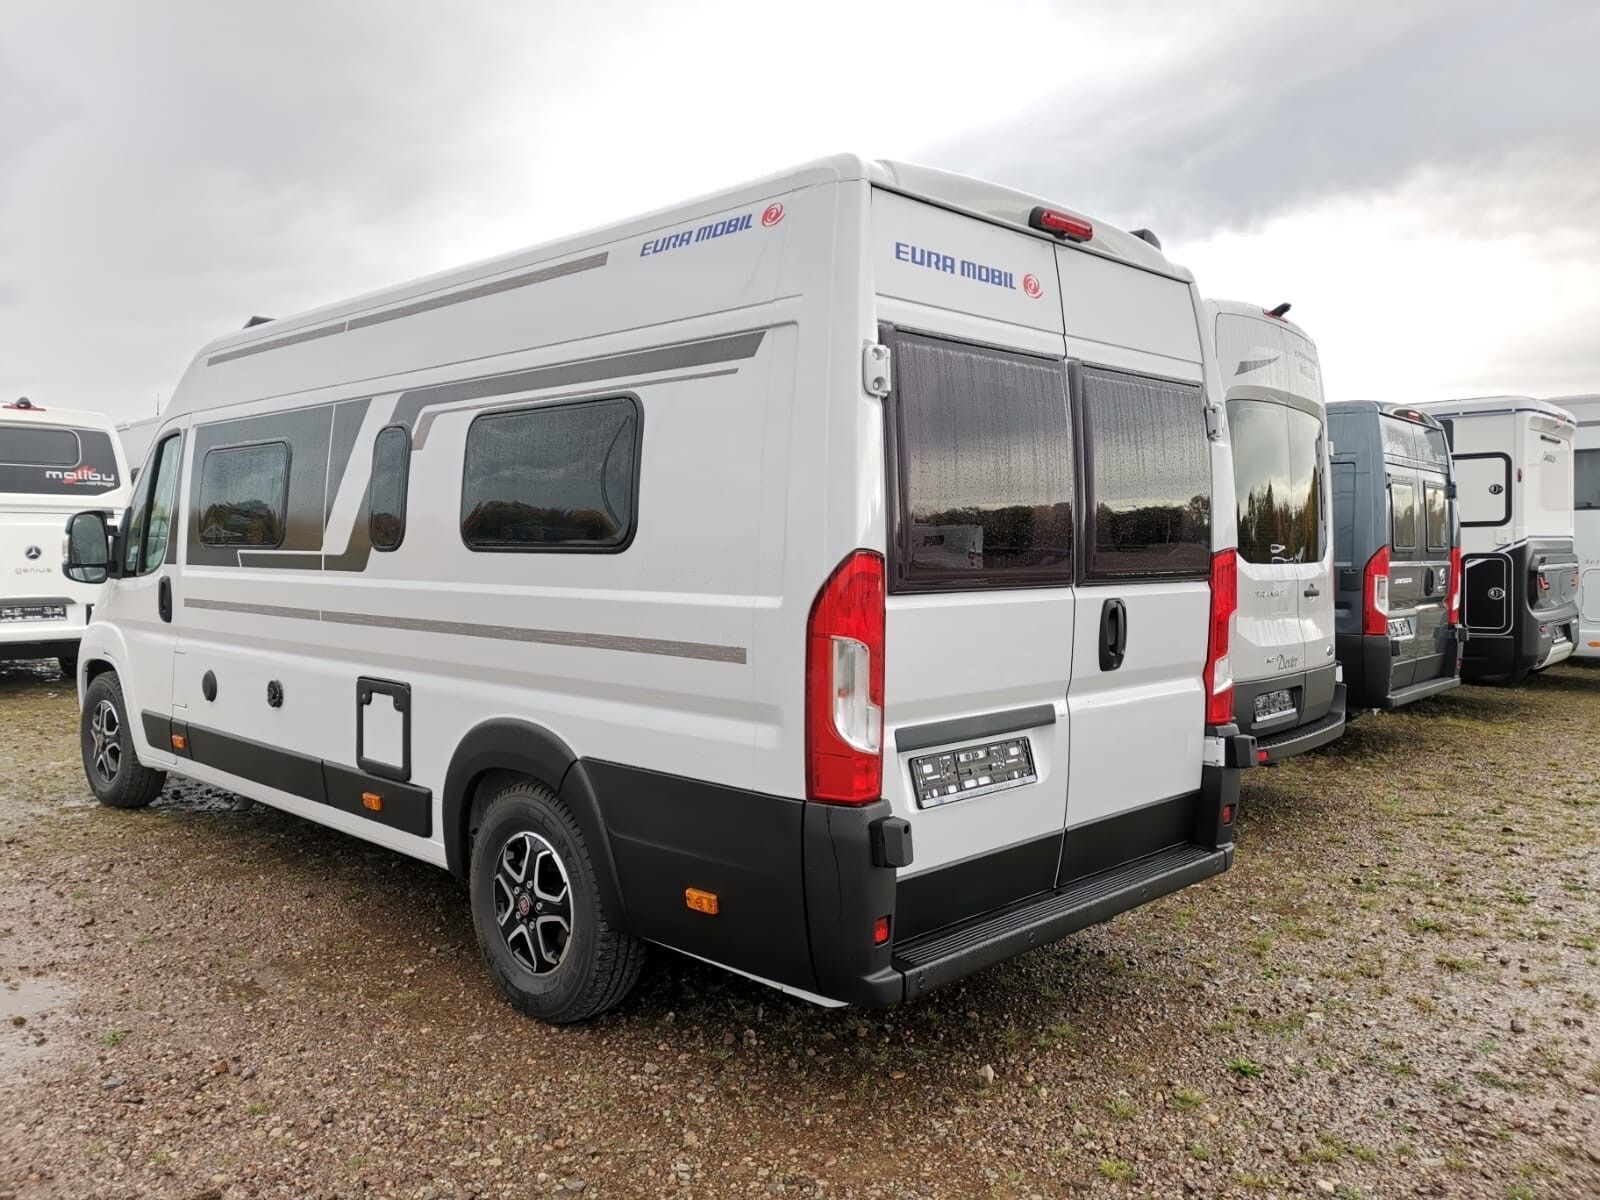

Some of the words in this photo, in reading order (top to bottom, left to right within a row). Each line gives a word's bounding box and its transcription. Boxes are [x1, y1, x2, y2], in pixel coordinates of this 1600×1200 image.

[640, 230, 693, 257] EURA
[695, 213, 753, 242] MOBIL
[895, 241, 955, 274] EURA
[960, 260, 1017, 290] MOBIL
[45, 470, 115, 481] malibu
[15, 567, 52, 575] genius
